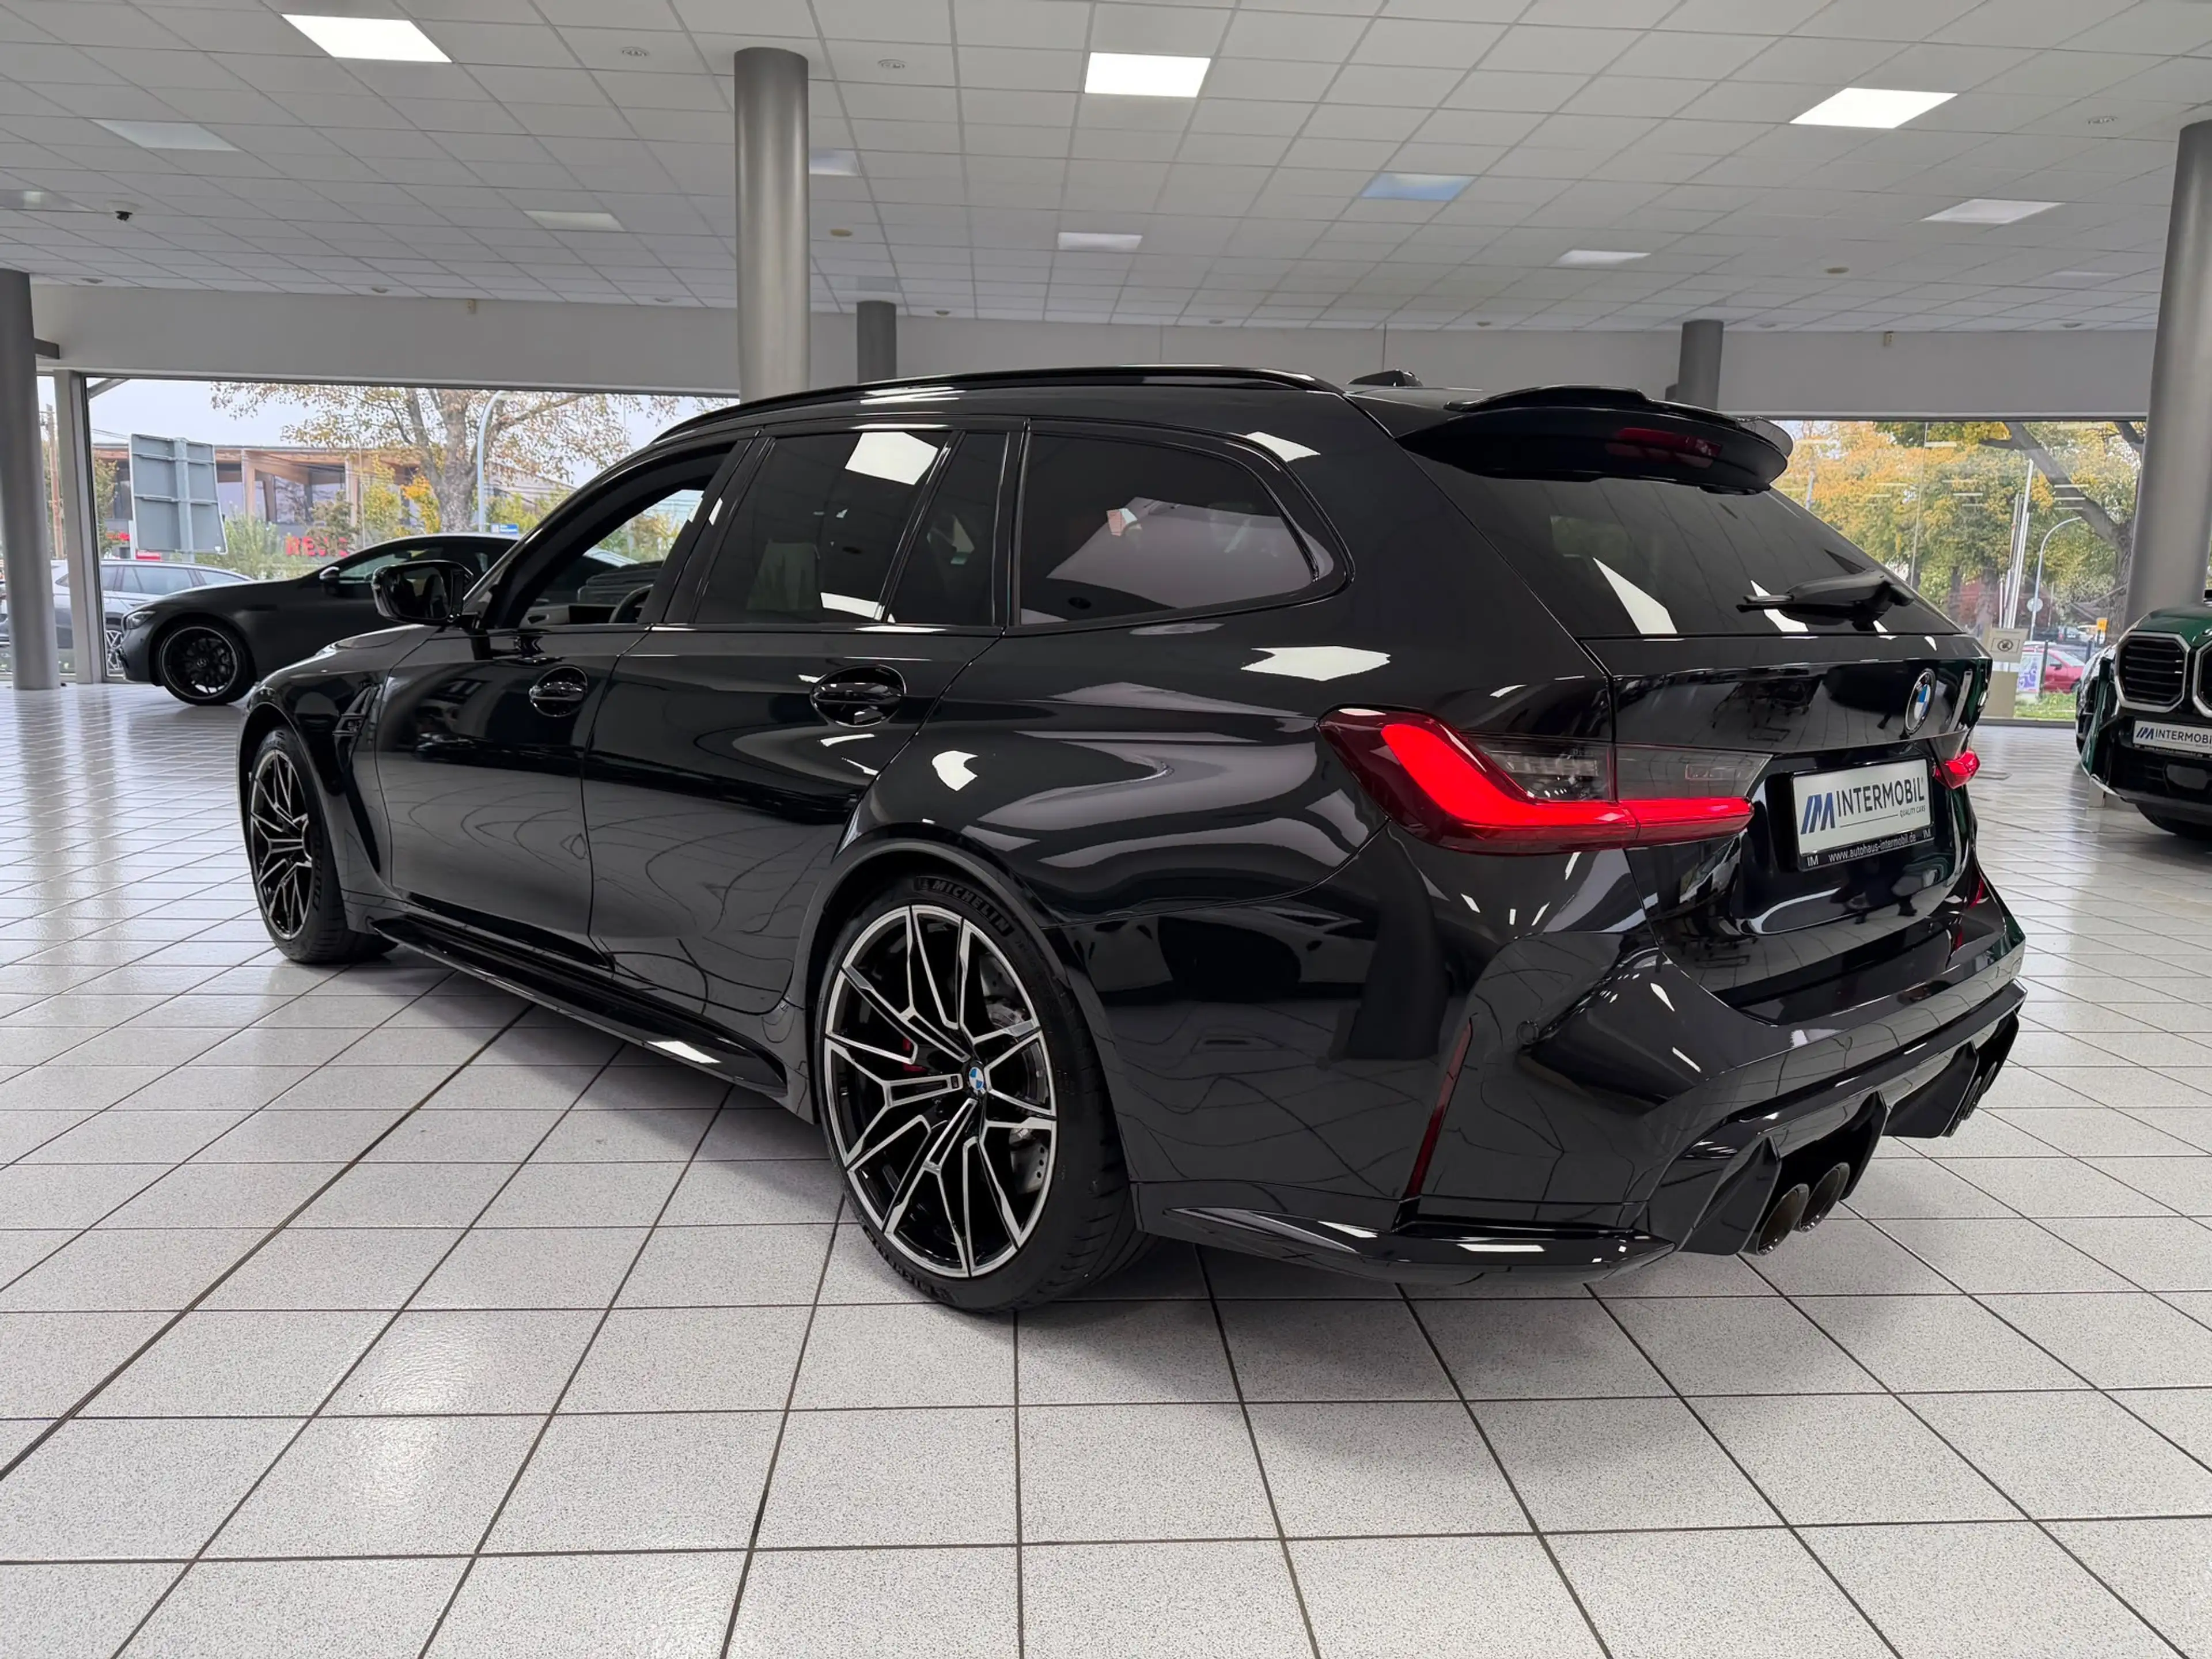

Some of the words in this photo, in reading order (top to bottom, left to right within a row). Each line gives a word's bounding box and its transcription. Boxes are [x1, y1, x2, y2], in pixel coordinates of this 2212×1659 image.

[1836, 777, 1925, 817] INTERMOBIL
[1828, 832, 1916, 863] www.autohaus-intermobil.de
[933, 880, 1010, 933] MICHELIN
